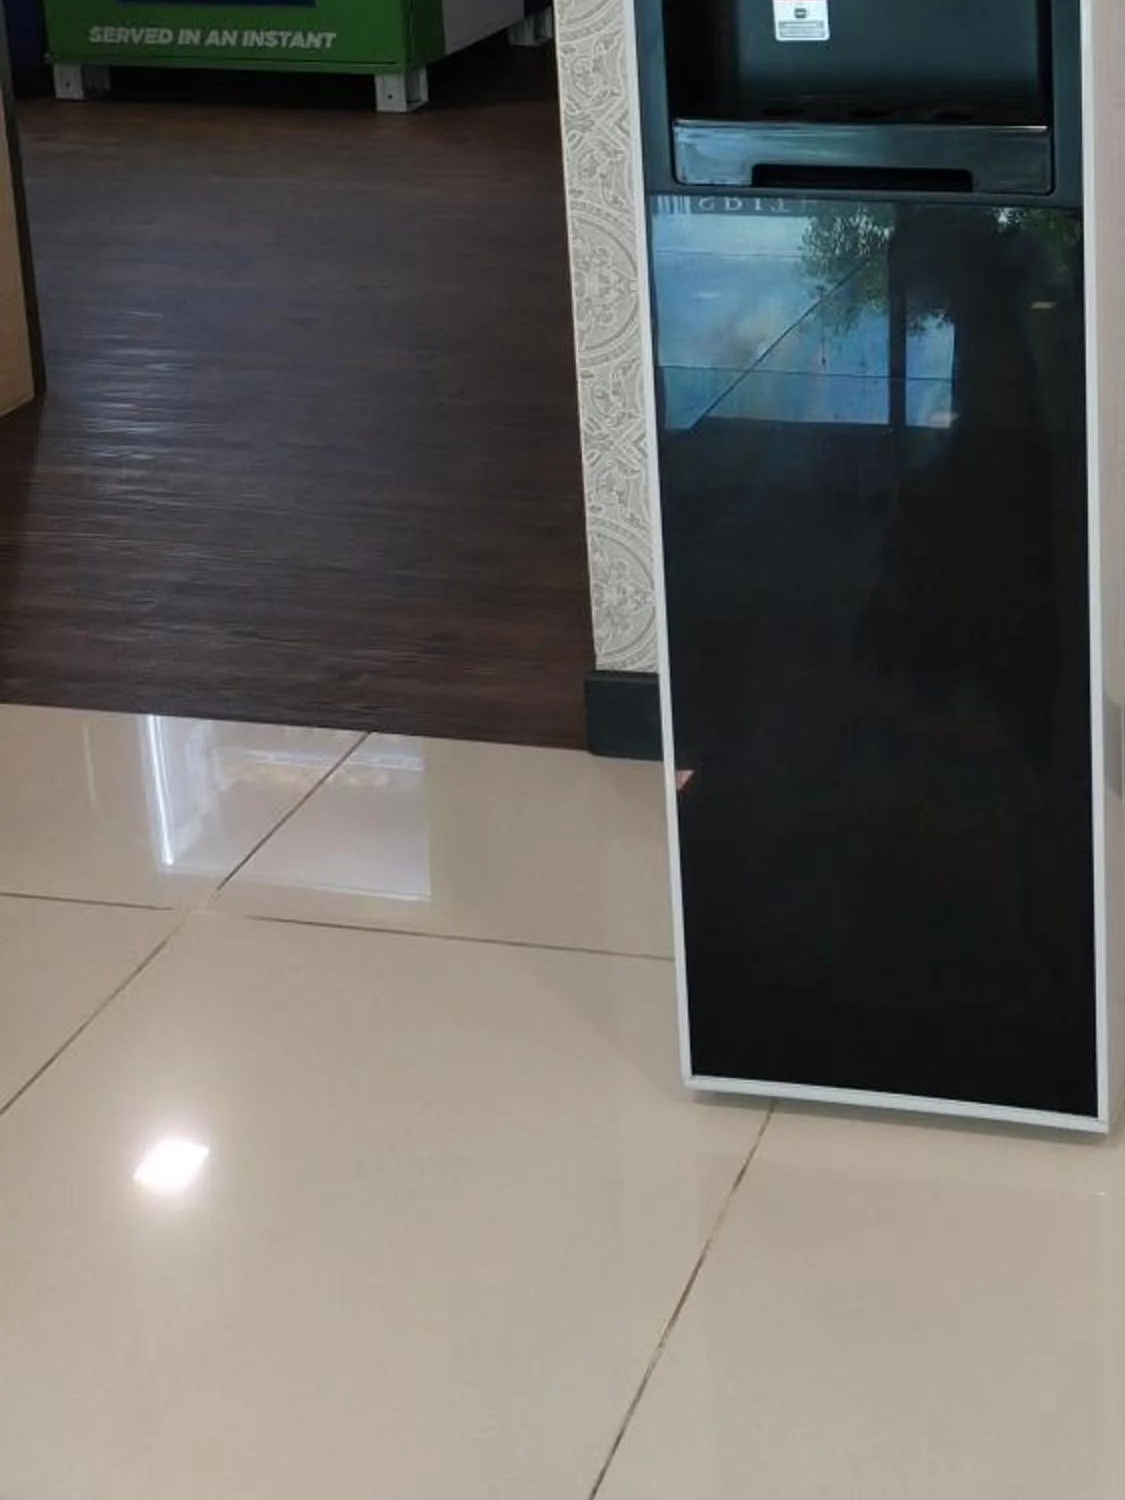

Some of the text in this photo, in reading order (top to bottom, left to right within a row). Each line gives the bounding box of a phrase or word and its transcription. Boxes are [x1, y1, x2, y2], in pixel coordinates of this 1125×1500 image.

[88, 25, 337, 49] SERVED IN AN INSTANT
